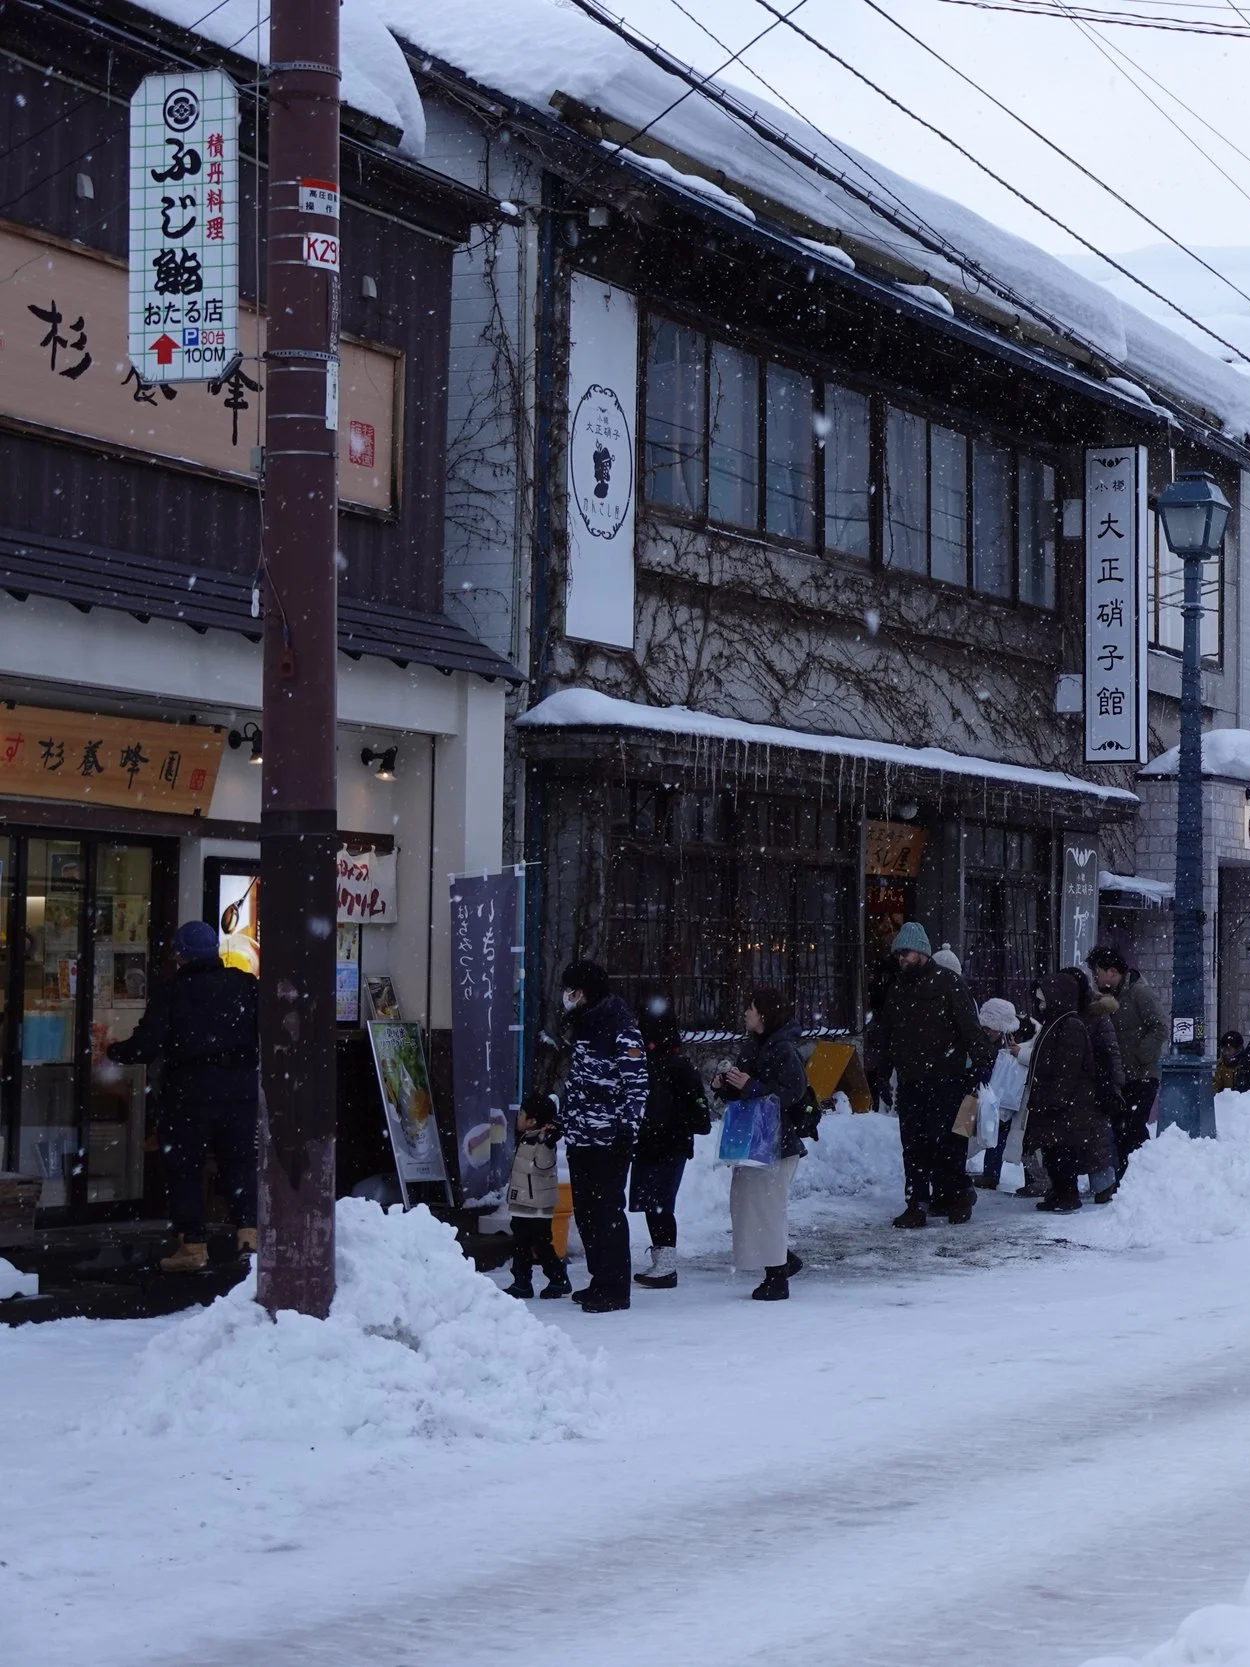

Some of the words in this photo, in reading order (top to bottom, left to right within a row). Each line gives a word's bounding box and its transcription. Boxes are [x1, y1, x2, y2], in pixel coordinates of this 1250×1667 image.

[206, 133, 224, 240] 積丹料理
[151, 138, 203, 295] ふじ鮨
[144, 298, 223, 325] おたる店
[201, 331, 225, 345] 30台
[184, 347, 225, 363] 100M
[586, 421, 621, 441] 大正硝子
[1097, 513, 1125, 716] 大正硝子館
